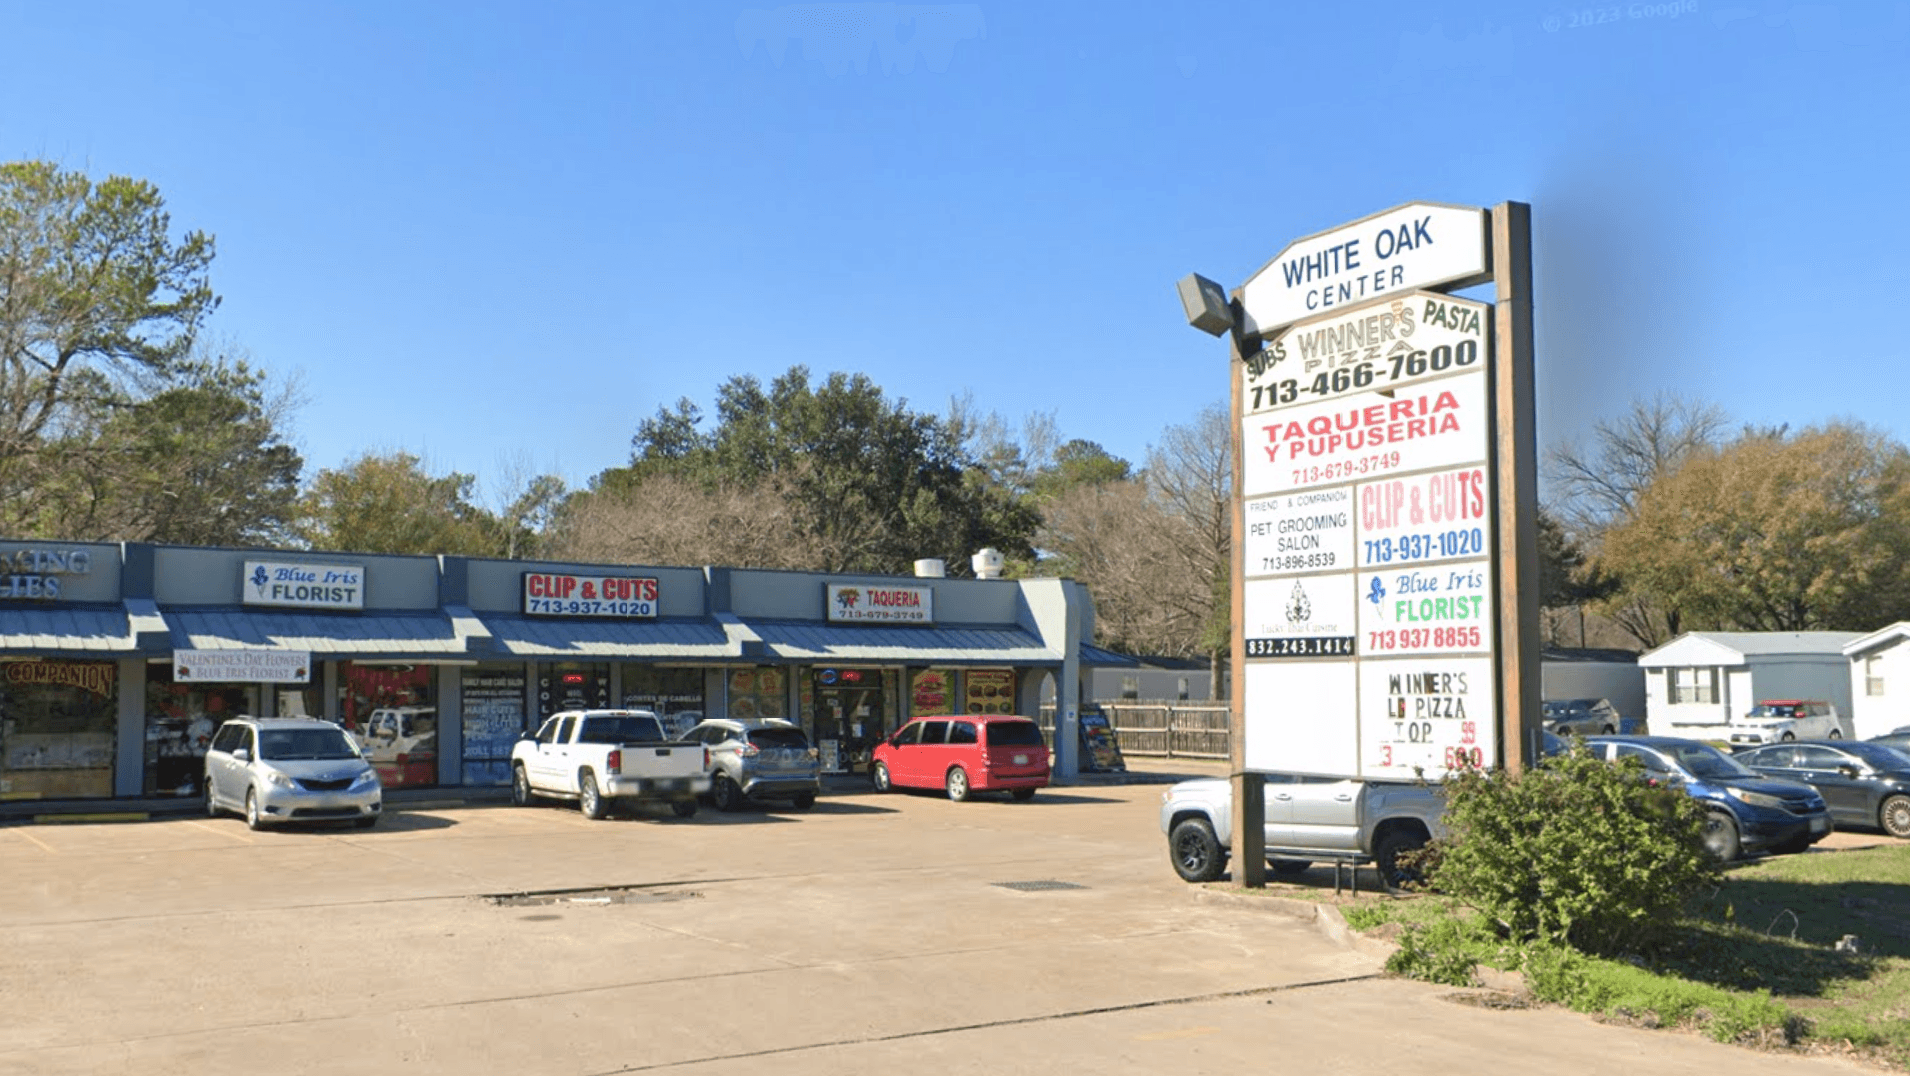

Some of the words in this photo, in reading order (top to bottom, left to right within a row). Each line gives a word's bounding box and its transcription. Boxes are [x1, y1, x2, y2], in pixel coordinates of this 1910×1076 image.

[1282, 239, 1360, 288] WHITE
[1375, 216, 1433, 260] OAK
[1306, 265, 1404, 311] CENTER
[1422, 300, 1480, 336] PASTA
[1297, 309, 1416, 360] WINNER'S
[1247, 342, 1287, 383] SUBS
[1305, 340, 1414, 373] PIZZA
[1250, 339, 1478, 410] 713-466-7600
[1262, 391, 1460, 443] TAQUERIA
[1264, 444, 1280, 463] Y
[1290, 413, 1460, 460] PUPUSERIA
[1292, 451, 1400, 485] 713-679-3749
[1250, 499, 1278, 512] FRIEND
[1297, 491, 1347, 507] COMPANION
[1361, 481, 1404, 532] CLIP
[1410, 485, 1425, 525] &
[1429, 469, 1484, 524] CUTS
[1250, 522, 1272, 536] PET
[1278, 512, 1347, 534] GROOMING
[1277, 535, 1320, 552] SALON
[1364, 527, 1483, 564] 713-937-1020
[1262, 552, 1336, 571] 713-896-8539
[273, 567, 317, 583] Blue
[321, 571, 358, 585] Iris
[529, 575, 577, 598] CLIP
[581, 581, 598, 599] &
[603, 578, 659, 601] CUTS
[1396, 574, 1438, 596] Blue
[1445, 570, 1483, 591] Iris
[272, 584, 356, 603] FLORIST
[867, 590, 921, 608] TAQUERIA
[530, 599, 651, 615] 713-937-1020
[839, 610, 924, 620] 713-679-3749
[1395, 595, 1484, 622] FLORIST
[1248, 638, 1352, 655] 832.243.1414
[1368, 630, 1396, 651] 713
[1399, 628, 1430, 649] 937
[1433, 626, 1480, 648] 8855
[5, 660, 113, 700] COMPANION
[1415, 697, 1467, 719] PIZZA
